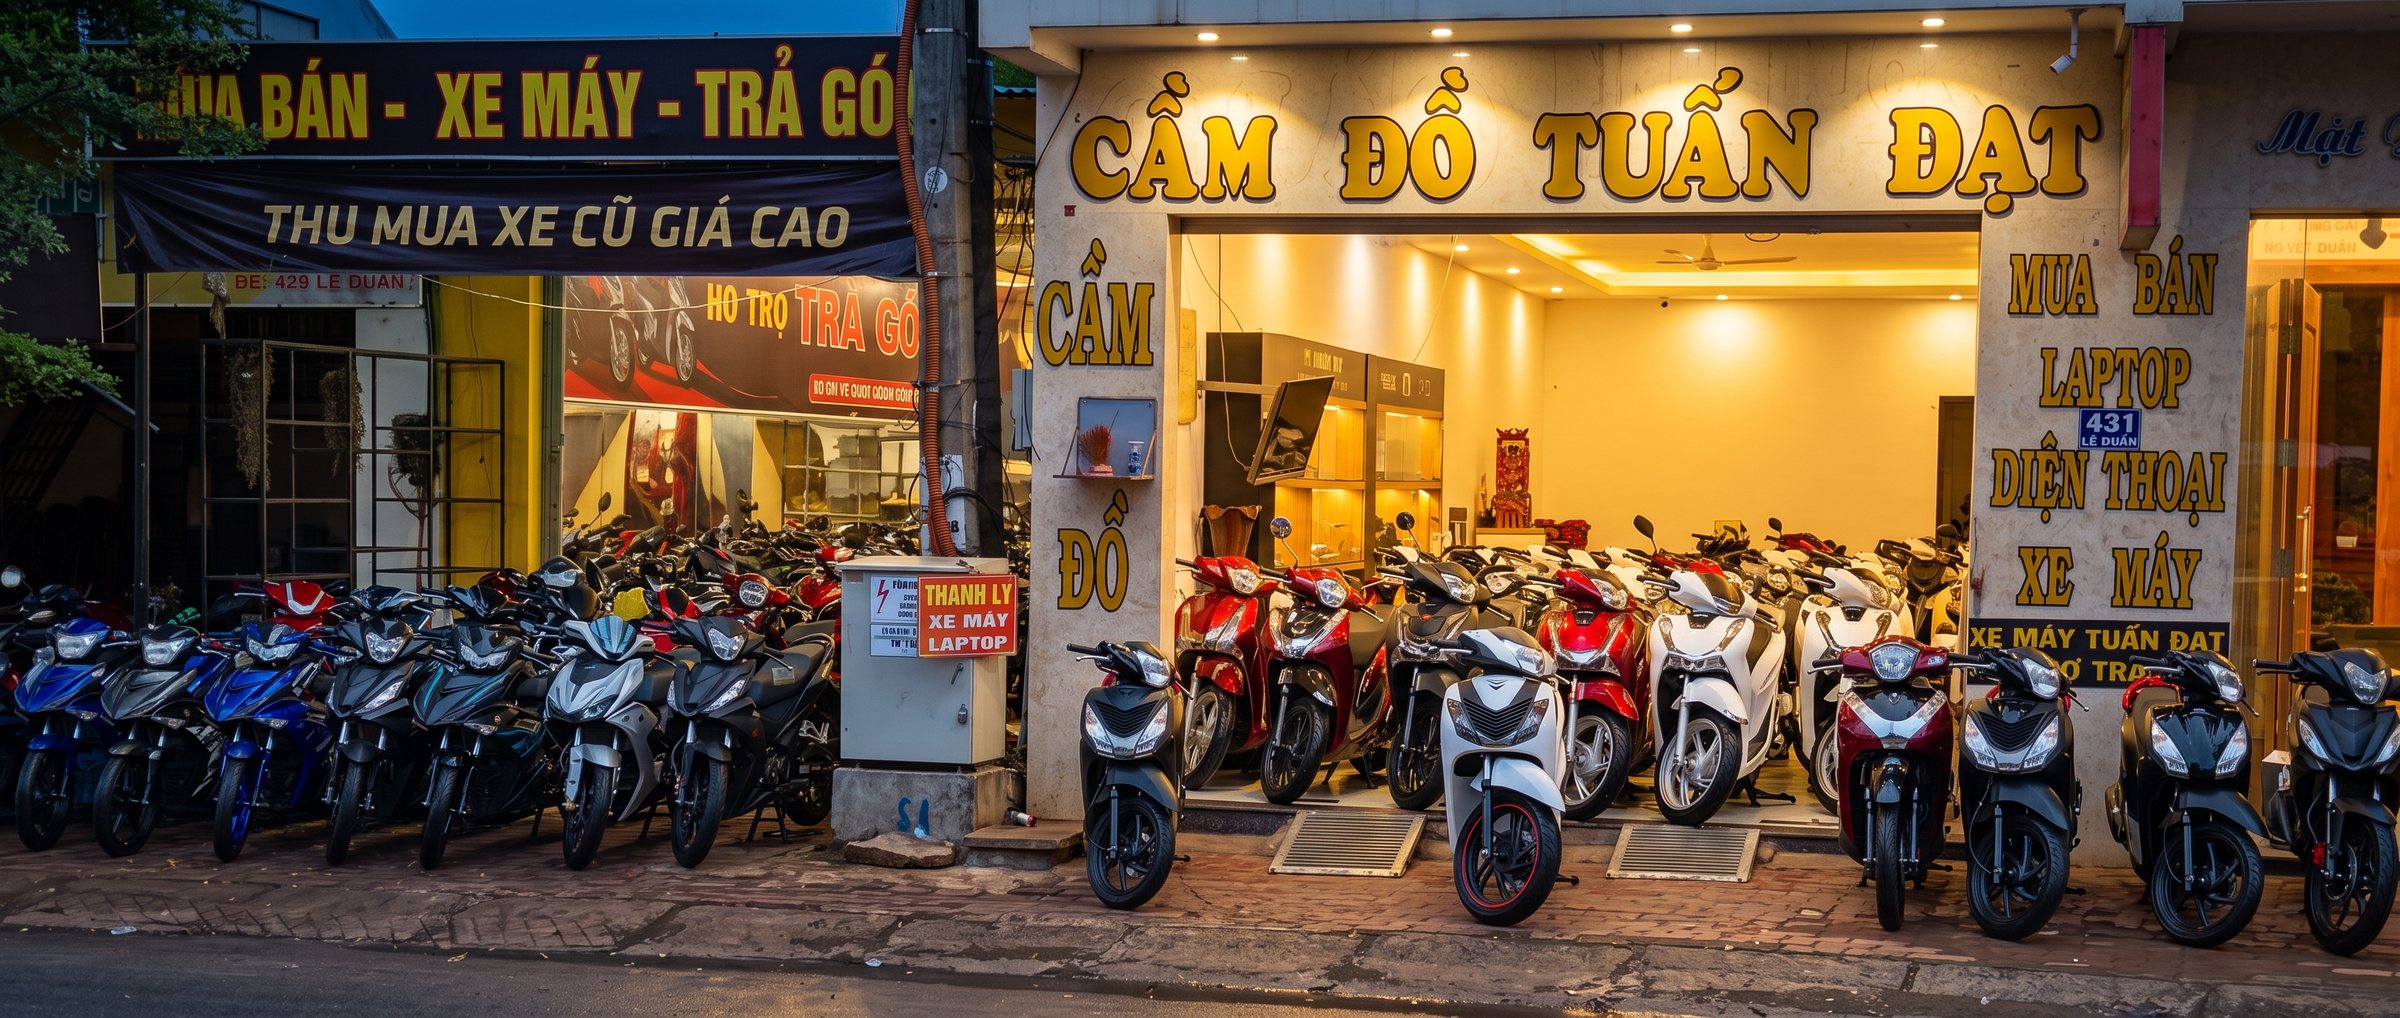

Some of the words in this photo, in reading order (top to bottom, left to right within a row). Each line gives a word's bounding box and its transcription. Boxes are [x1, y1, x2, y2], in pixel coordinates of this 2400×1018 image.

[259, 56, 368, 140] BÁN
[435, 70, 504, 139] XE
[521, 54, 643, 139] MÁY
[694, 44, 804, 139] TRẢ
[821, 51, 914, 138] GÓ
[1071, 70, 1278, 201] CẦM
[1339, 65, 1477, 201] ĐỒ
[1532, 66, 1818, 201] TUẤN
[1885, 103, 2102, 215] ĐẠT
[264, 205, 358, 245] THU
[371, 205, 478, 246] MUA
[491, 205, 559, 247] XE
[572, 194, 636, 247] CŨ
[650, 194, 732, 248] GIÁ
[750, 206, 850, 248] CAO
[275, 274, 309, 289] 429
[1037, 237, 1155, 367] CẦM
[2007, 253, 2098, 315] MUA
[2133, 234, 2218, 315] BÁN
[2039, 346, 2191, 409] LAPTOP
[2082, 434, 2097, 446] LÊ
[2086, 412, 2133, 433] 431
[2101, 450, 2228, 527] THOẠI
[1057, 488, 1129, 612] ĐỒ
[2016, 546, 2074, 607] XE
[2111, 530, 2202, 610] MÁY
[925, 583, 986, 606] THANH
[929, 614, 955, 629] XE
[963, 611, 1008, 629] MÁY
[929, 636, 1008, 652] LAPTOP
[1970, 627, 2003, 647] XE
[2013, 624, 2075, 649] MÁY
